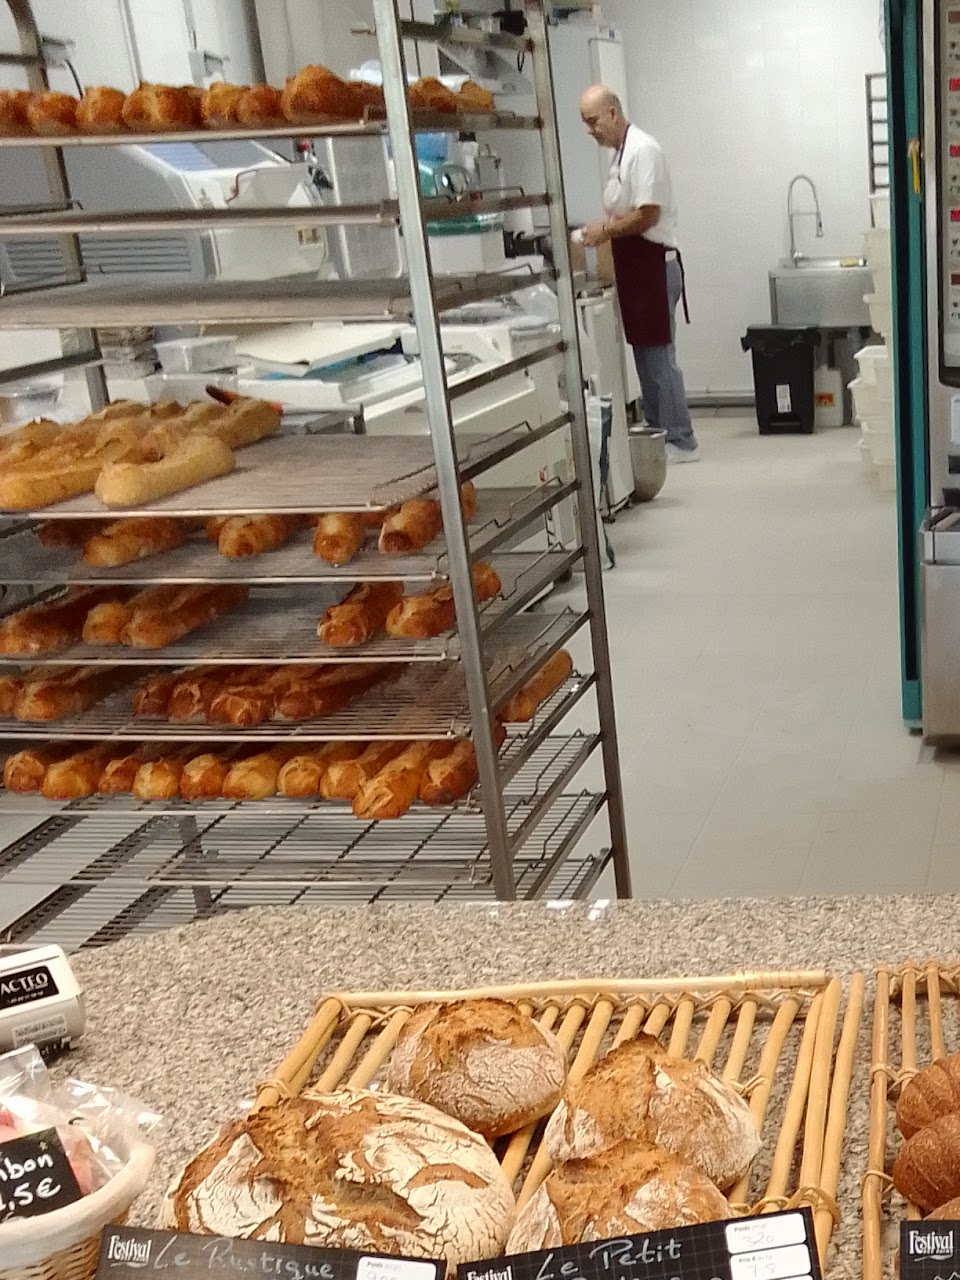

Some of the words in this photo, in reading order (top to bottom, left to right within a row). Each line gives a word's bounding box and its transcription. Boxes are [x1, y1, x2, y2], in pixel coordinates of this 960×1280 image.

[107, 1235, 152, 1263] Festival
[153, 1234, 191, 1270] Le
[202, 1237, 334, 1279] Rustique
[589, 1238, 682, 1270] Petit
[909, 1230, 955, 1255] Festival
